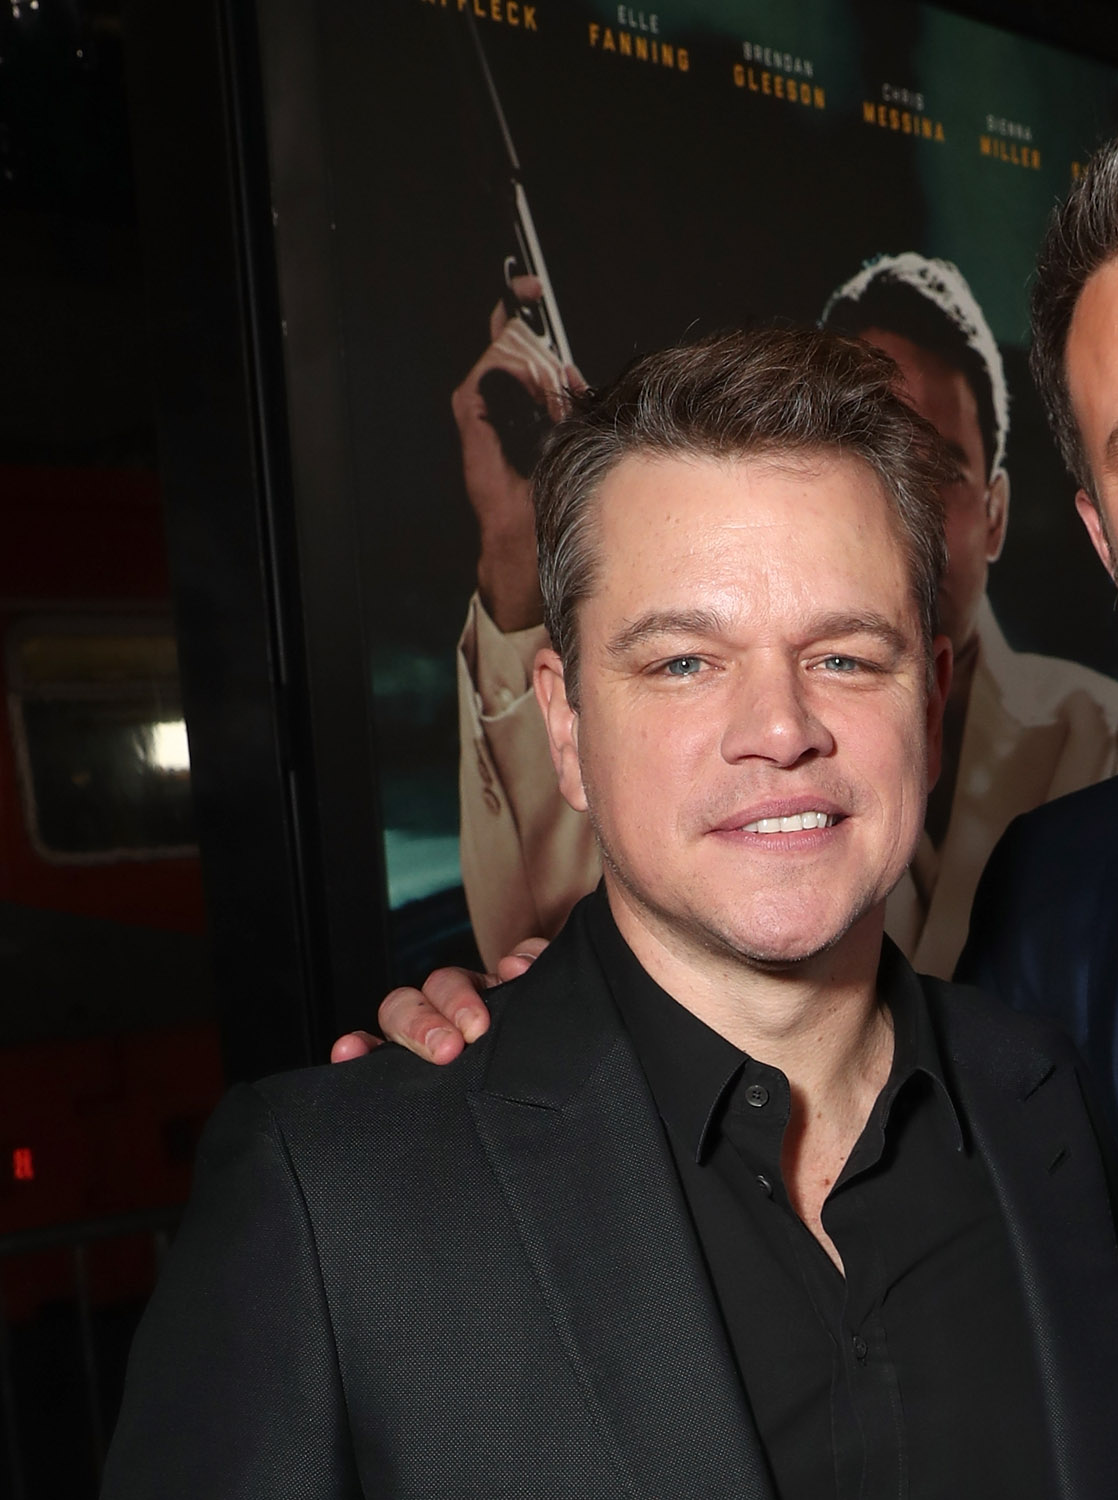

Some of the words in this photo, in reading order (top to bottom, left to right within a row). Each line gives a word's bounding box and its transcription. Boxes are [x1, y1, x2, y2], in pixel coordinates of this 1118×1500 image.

[418, 0, 537, 31] LECK
[617, 4, 659, 34] ELLE
[588, 21, 690, 72] FANNING
[743, 41, 813, 78] BRENDAN
[733, 63, 825, 110] GLEESON
[881, 83, 924, 111] CHRIS
[863, 101, 945, 142] MESSINA
[979, 134, 1041, 170] MILLER
